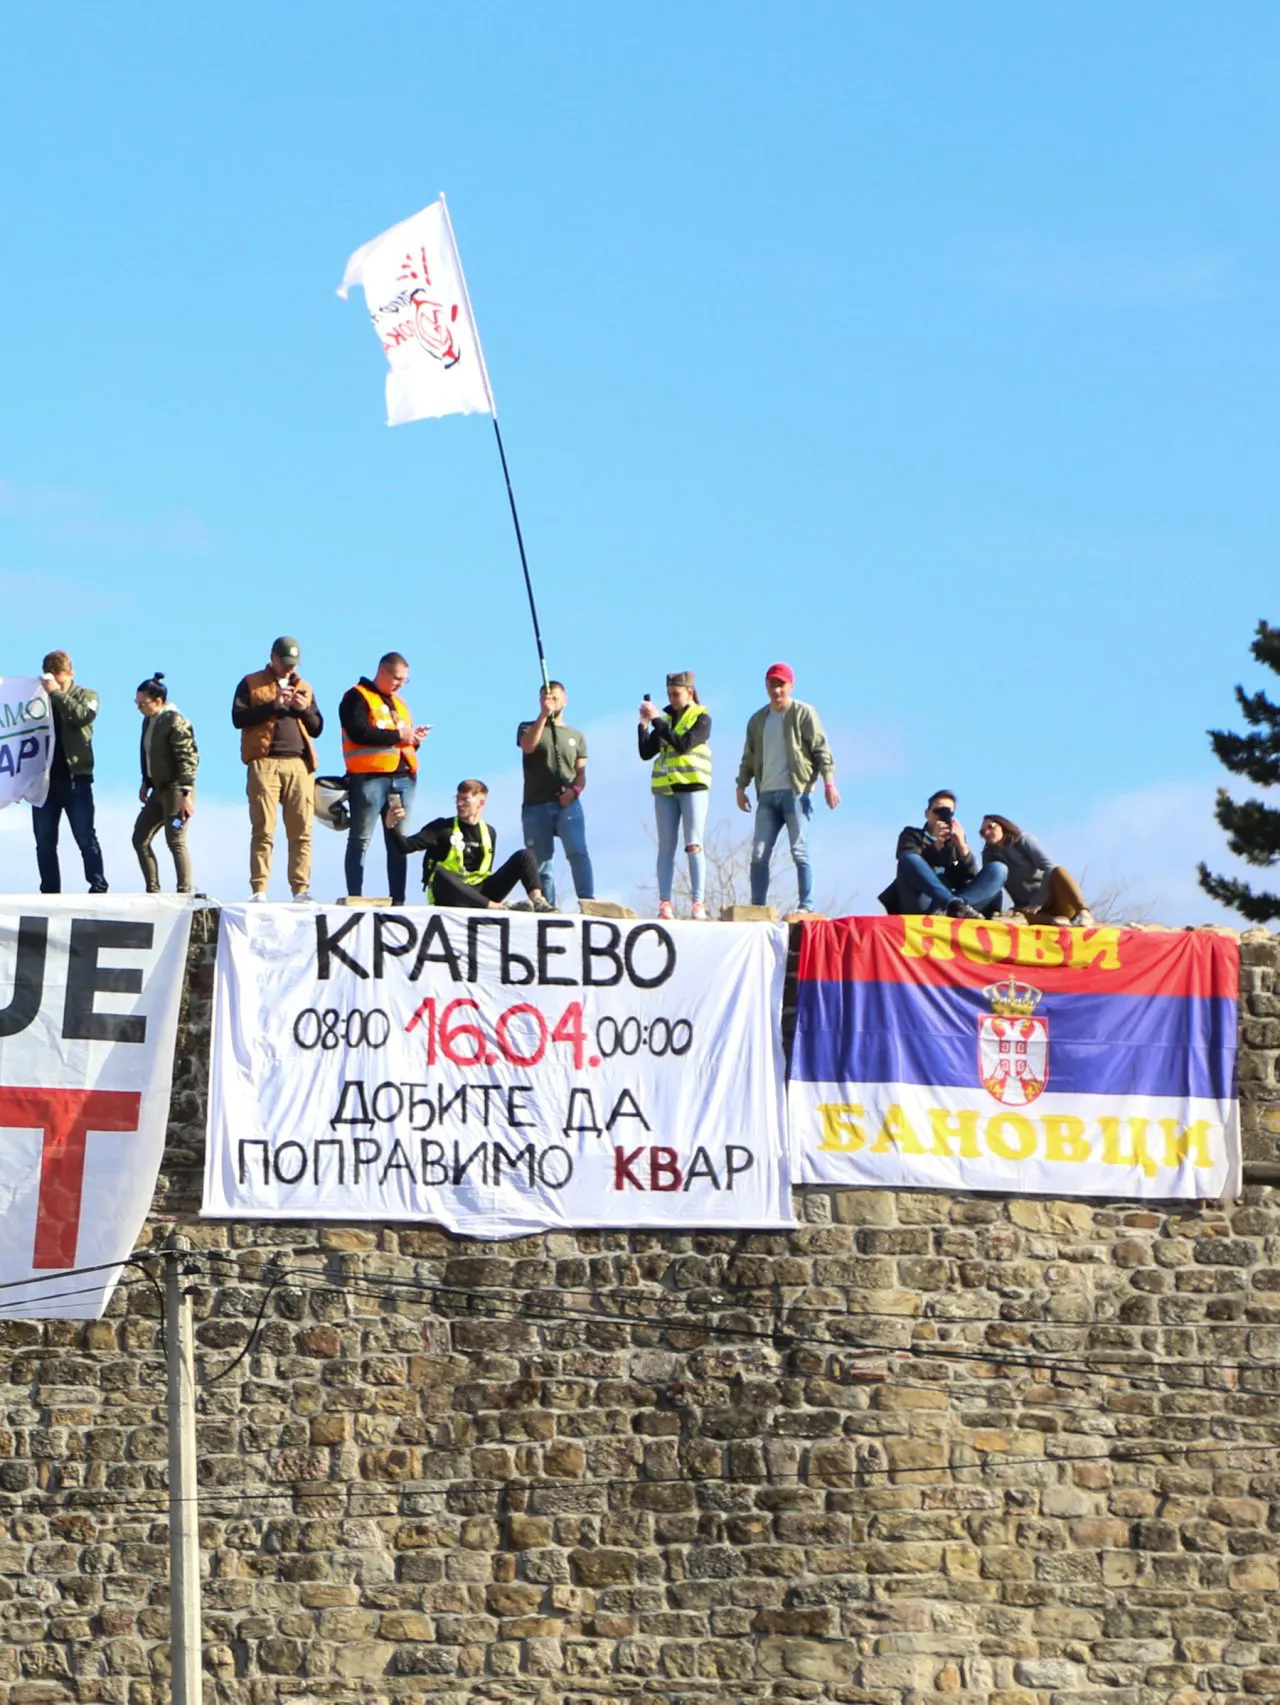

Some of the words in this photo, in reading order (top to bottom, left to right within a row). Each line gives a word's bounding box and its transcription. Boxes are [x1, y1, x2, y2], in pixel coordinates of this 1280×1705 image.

[315, 912, 676, 988] КРАЉЕВО
[900, 913, 1122, 970] НОВИ
[293, 1007, 390, 1050] 08:00
[404, 996, 603, 1070] 16.04.
[597, 1015, 694, 1057] 00:00
[330, 1080, 536, 1131] ДОЂИТЕ
[564, 1087, 651, 1137] ДА
[816, 1103, 1215, 1178] БАНОВЦИ
[238, 1137, 574, 1189] ПОПРАВИМО
[613, 1144, 755, 1192] КВАР
